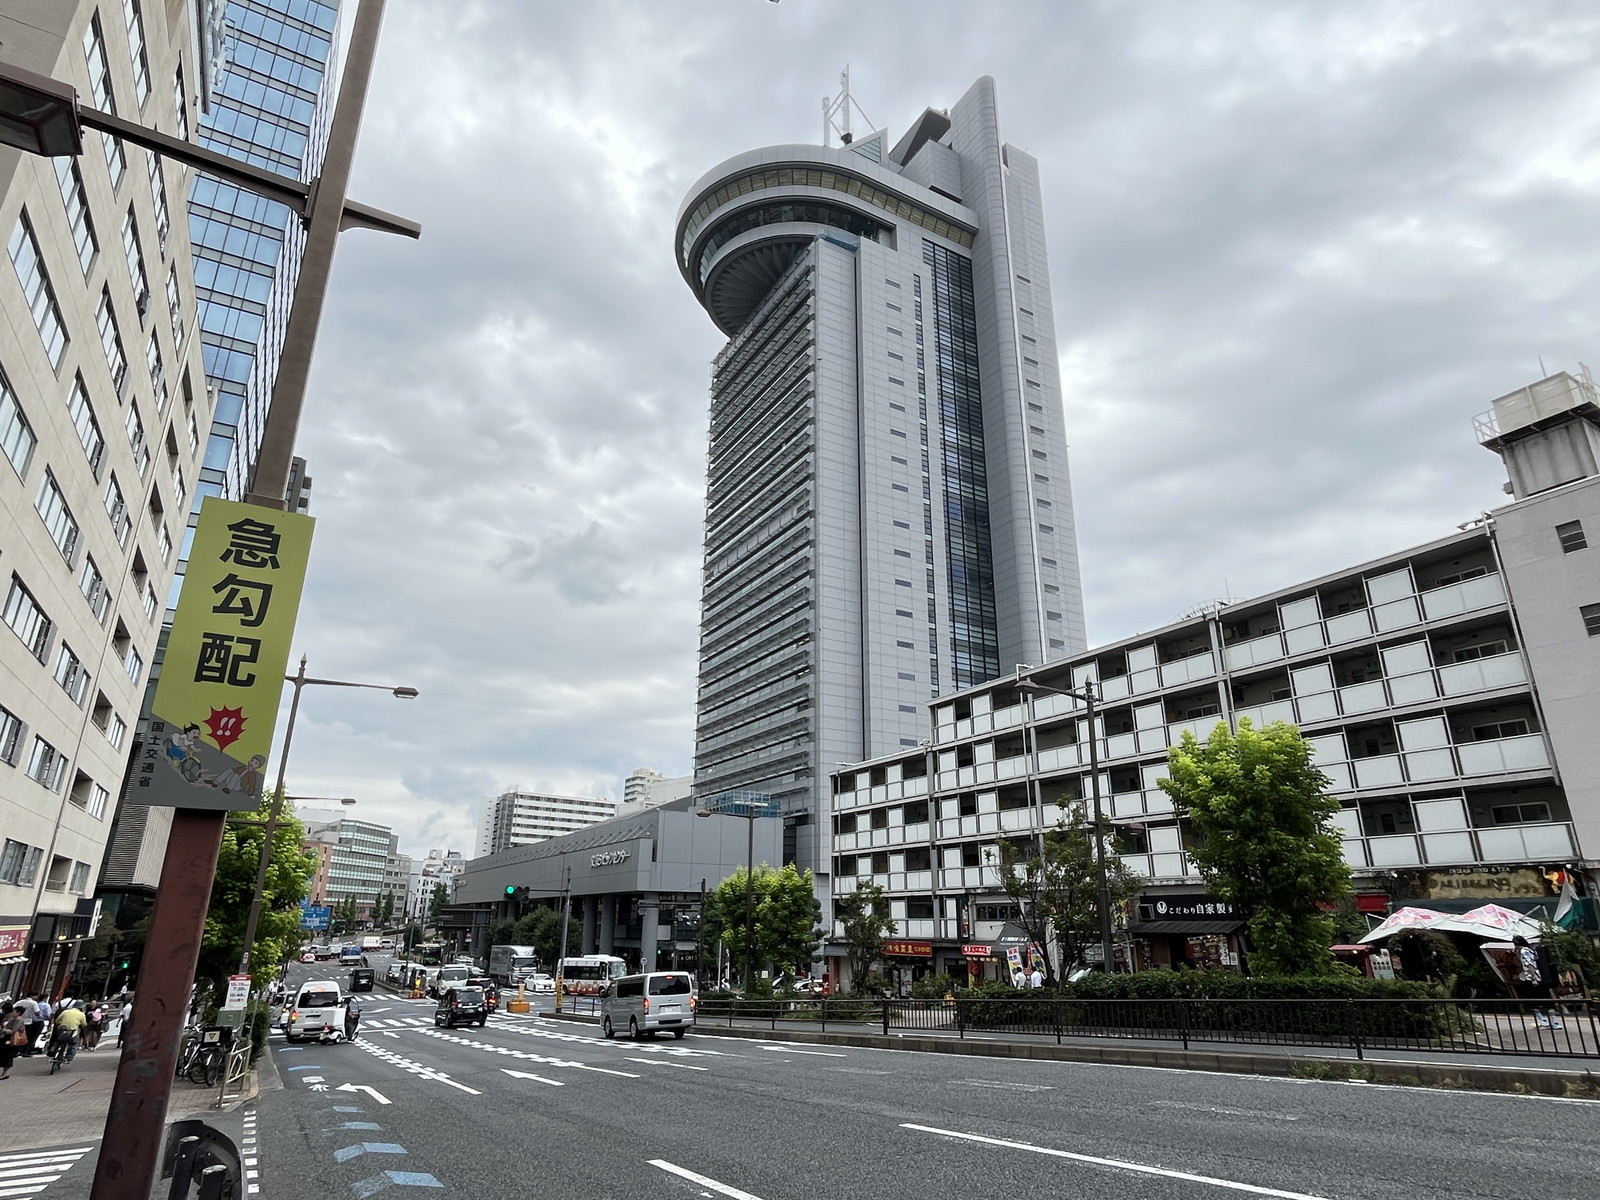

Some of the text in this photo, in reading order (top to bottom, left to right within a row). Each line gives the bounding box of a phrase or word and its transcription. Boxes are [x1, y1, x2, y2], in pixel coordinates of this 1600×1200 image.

[194, 517, 282, 687] 急勾配
[137, 721, 166, 788] 国土交通省
